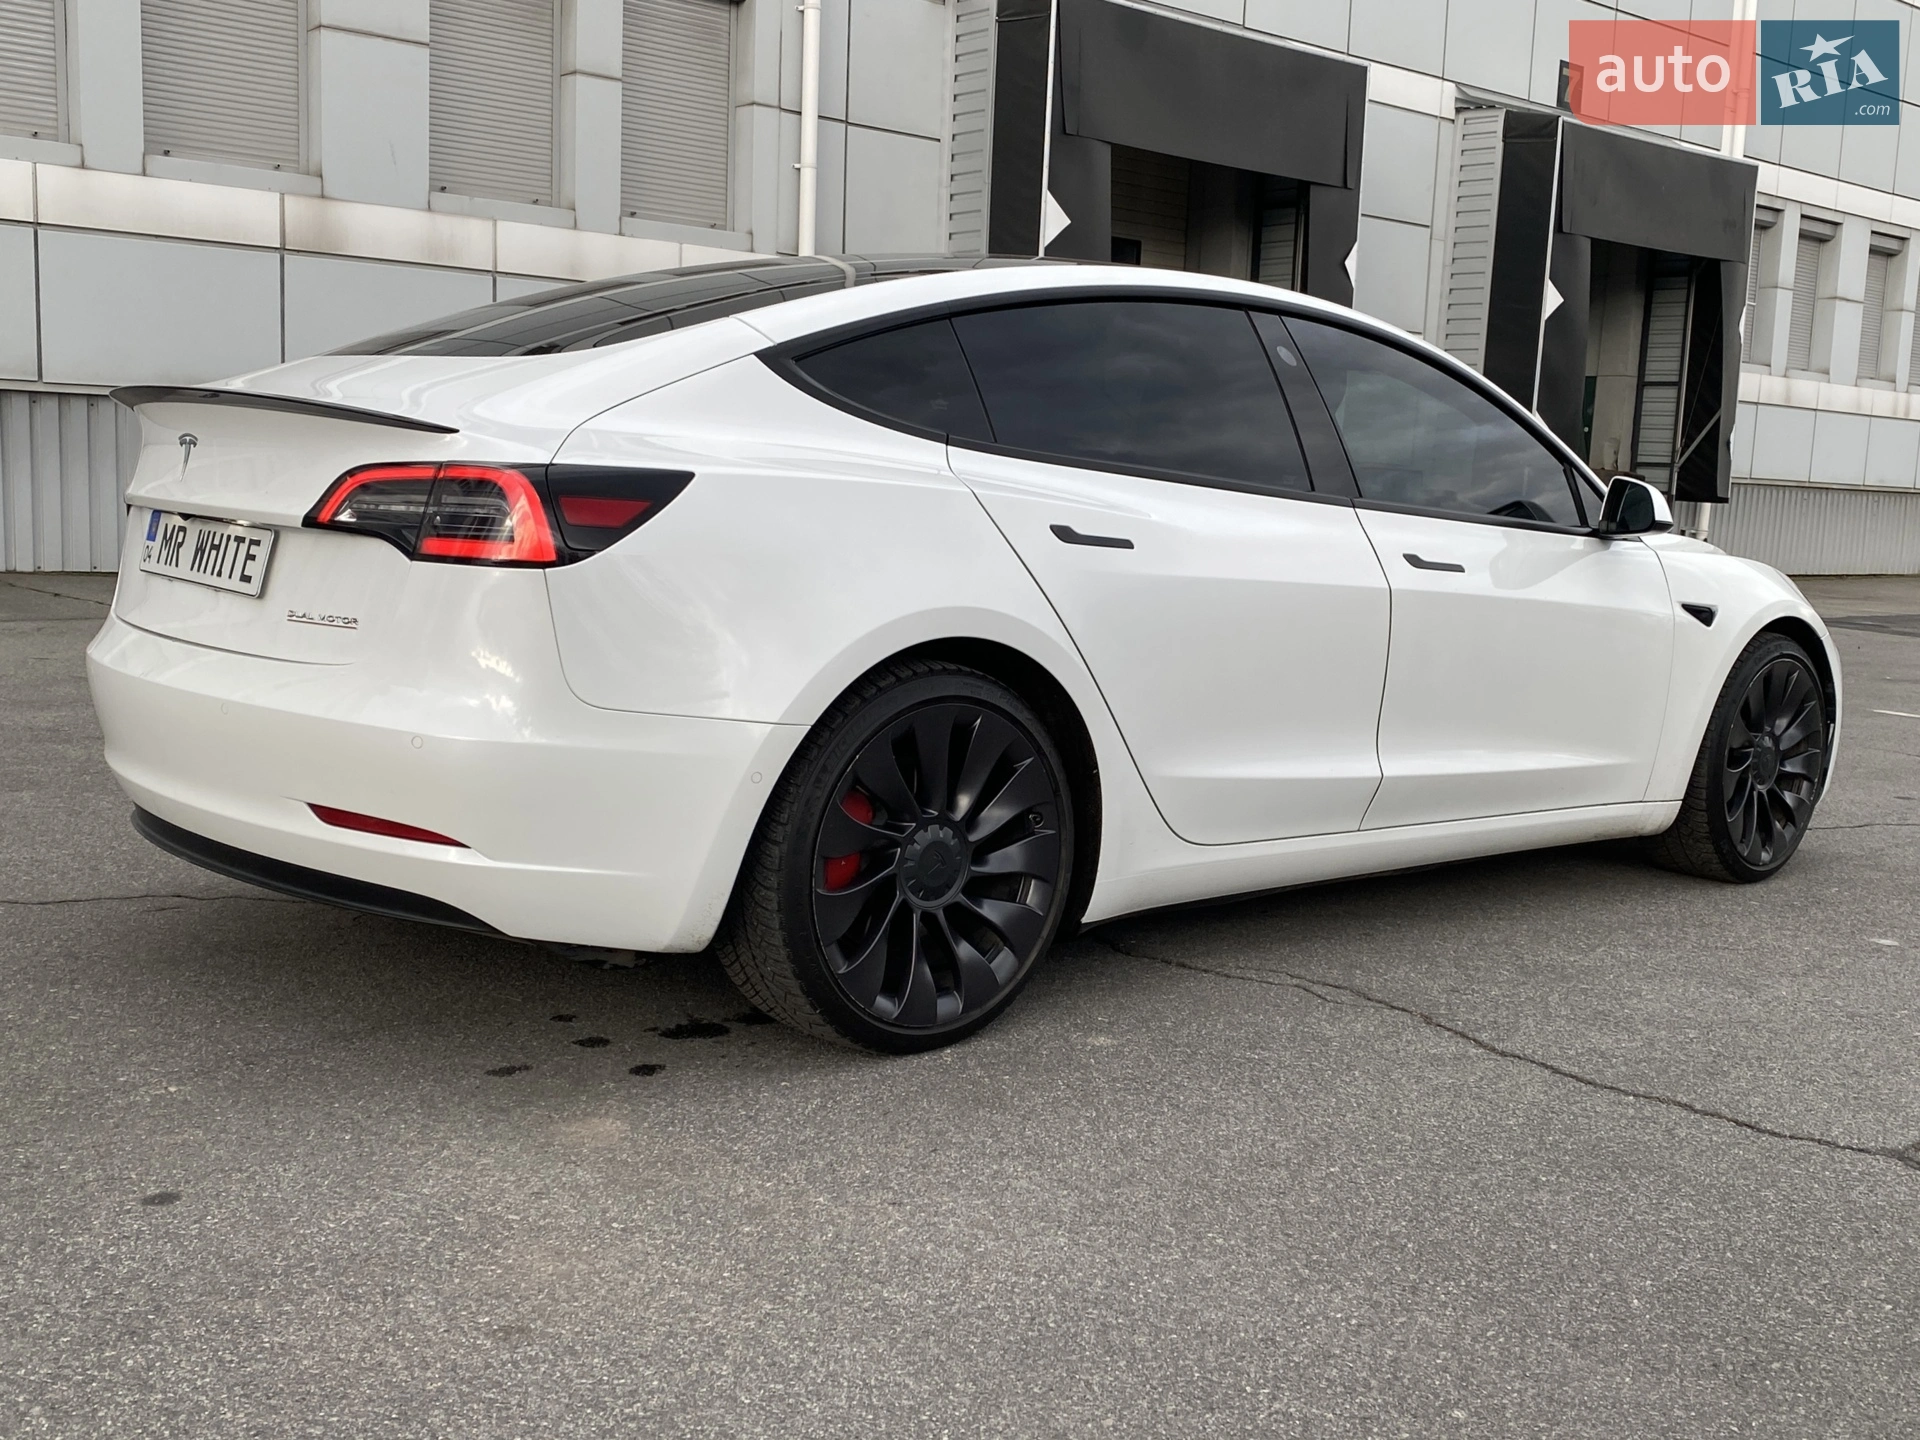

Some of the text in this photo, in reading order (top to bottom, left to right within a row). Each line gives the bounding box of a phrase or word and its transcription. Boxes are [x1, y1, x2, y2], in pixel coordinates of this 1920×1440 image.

[1562, 67, 1581, 103] 7
[156, 522, 262, 584] MR WHITE
[318, 613, 359, 626] MOTOR
